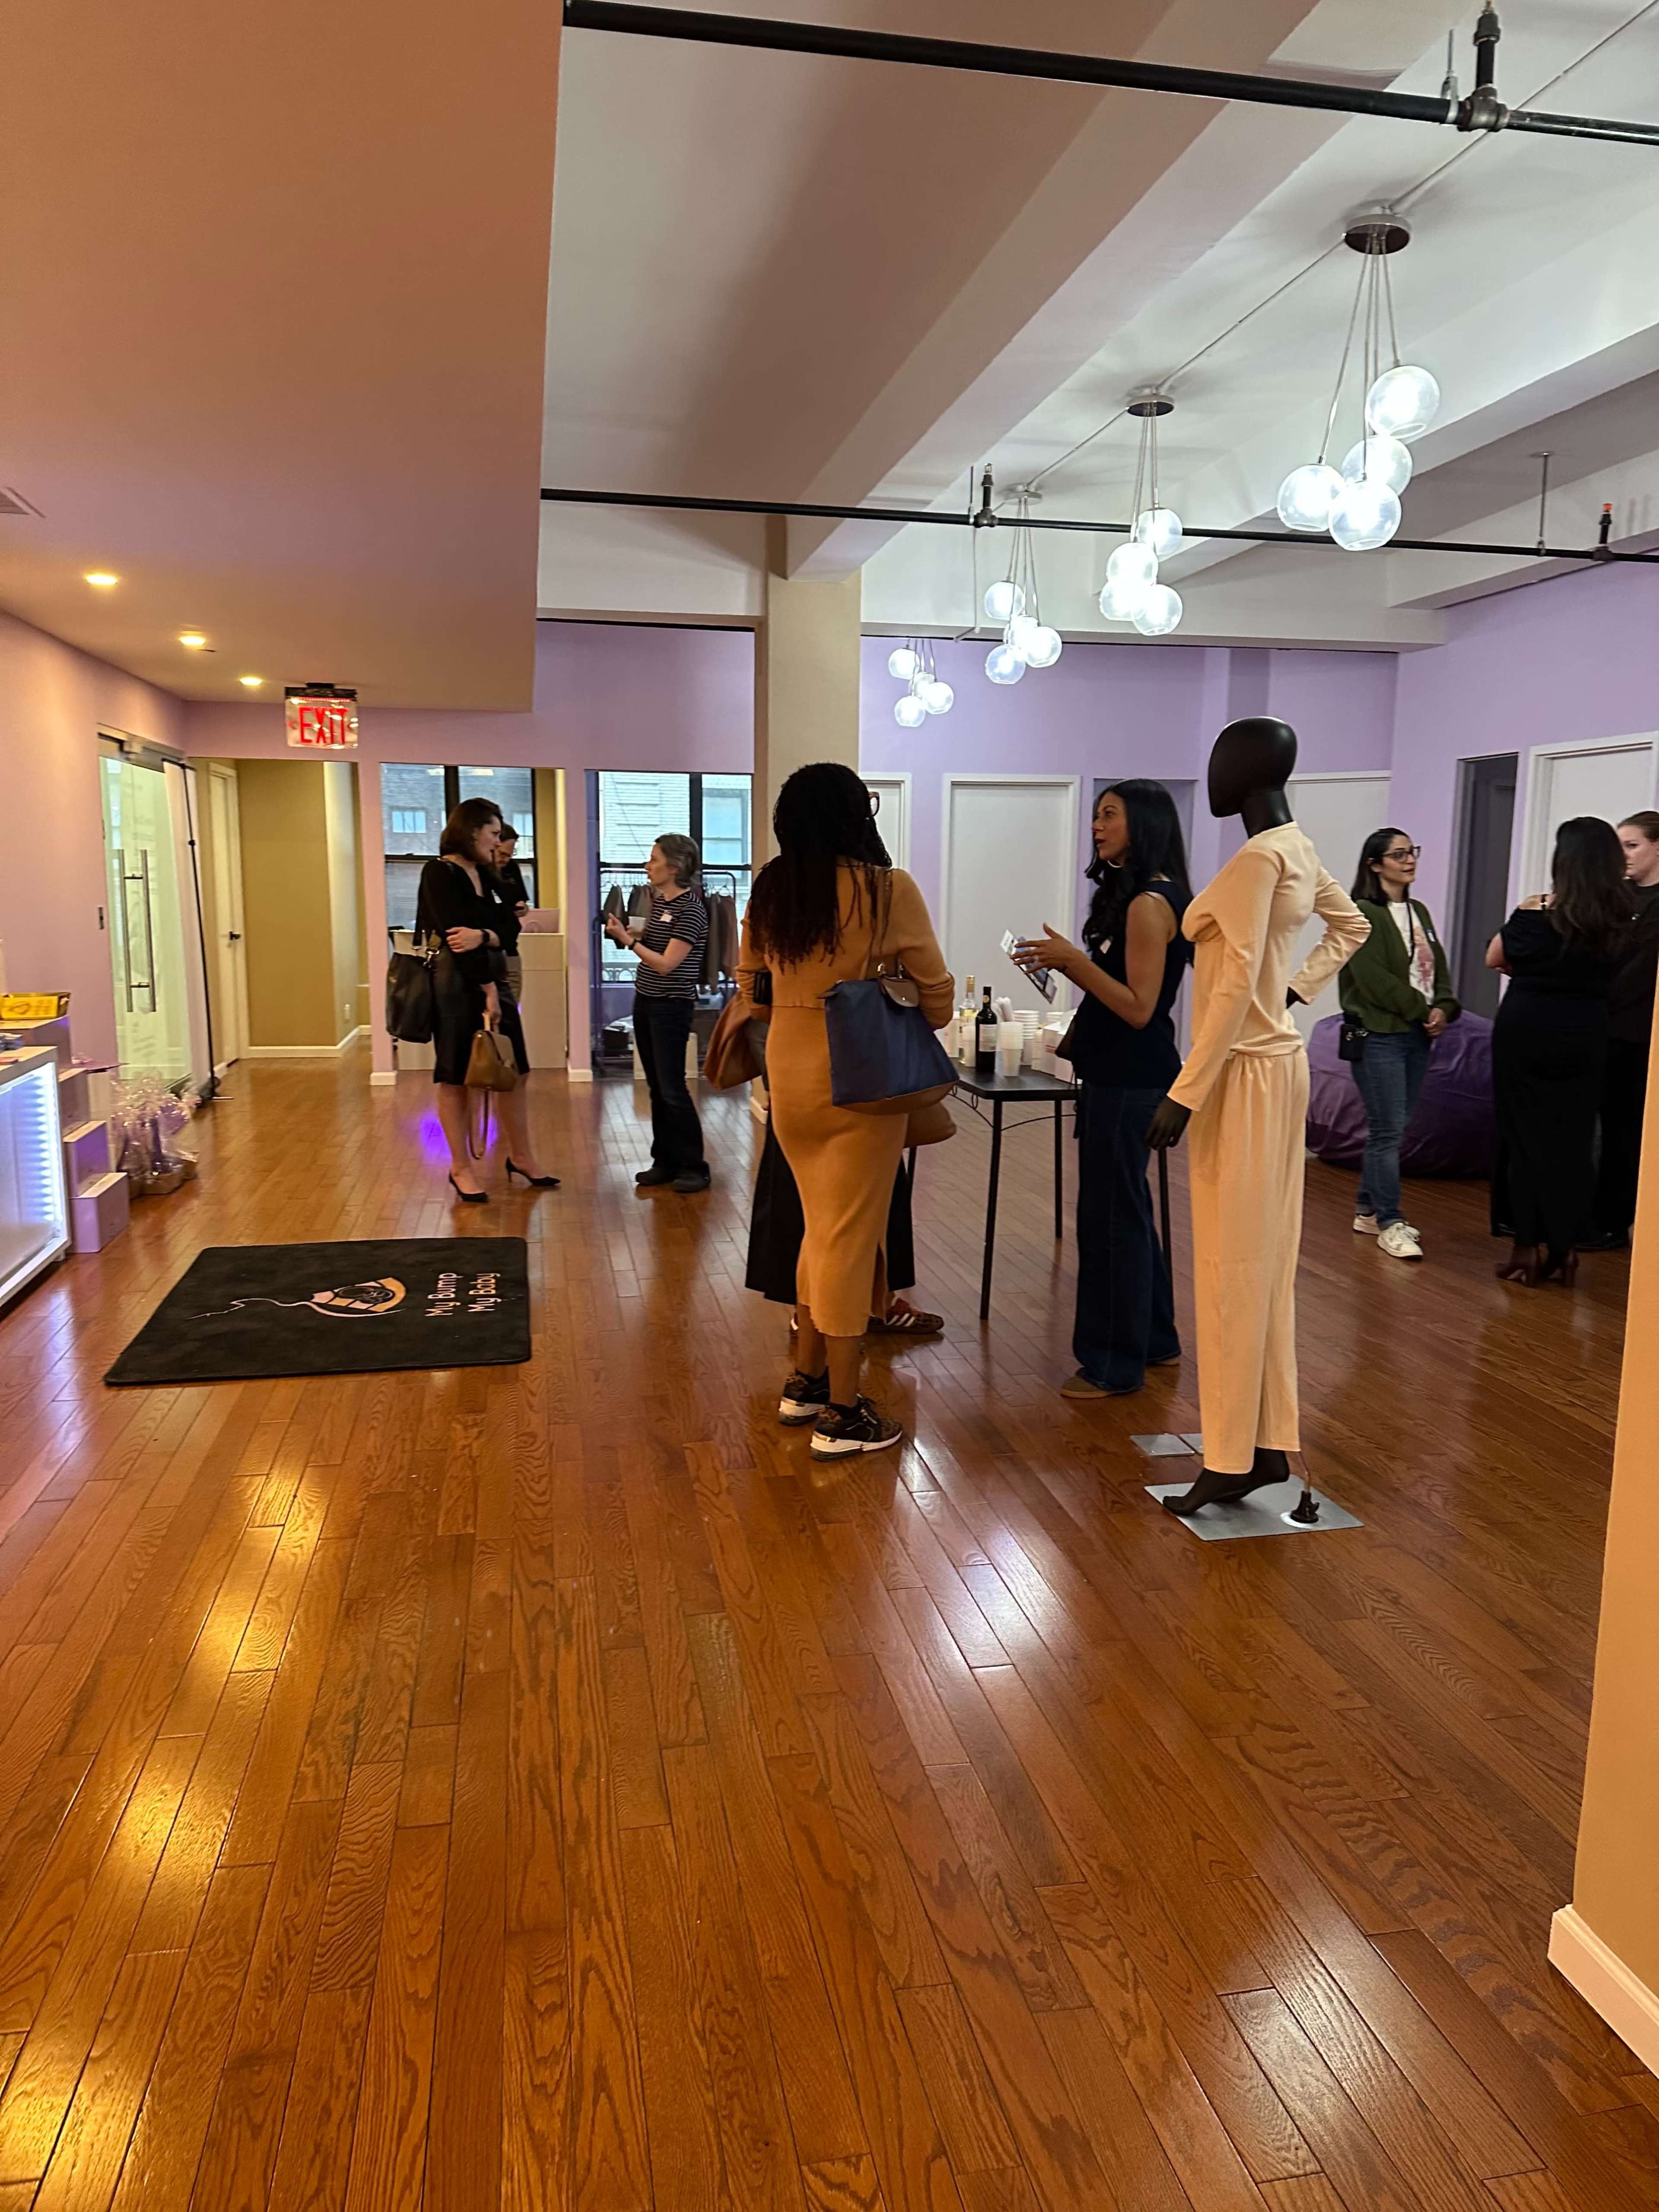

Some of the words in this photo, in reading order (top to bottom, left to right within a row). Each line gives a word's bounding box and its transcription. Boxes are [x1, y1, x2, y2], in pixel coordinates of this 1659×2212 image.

[299, 707, 348, 744] EXIT
[428, 1273, 464, 1299] Bump
[468, 1273, 501, 1294] Baby
[425, 1302, 461, 1316] My
[467, 1297, 502, 1312] My
